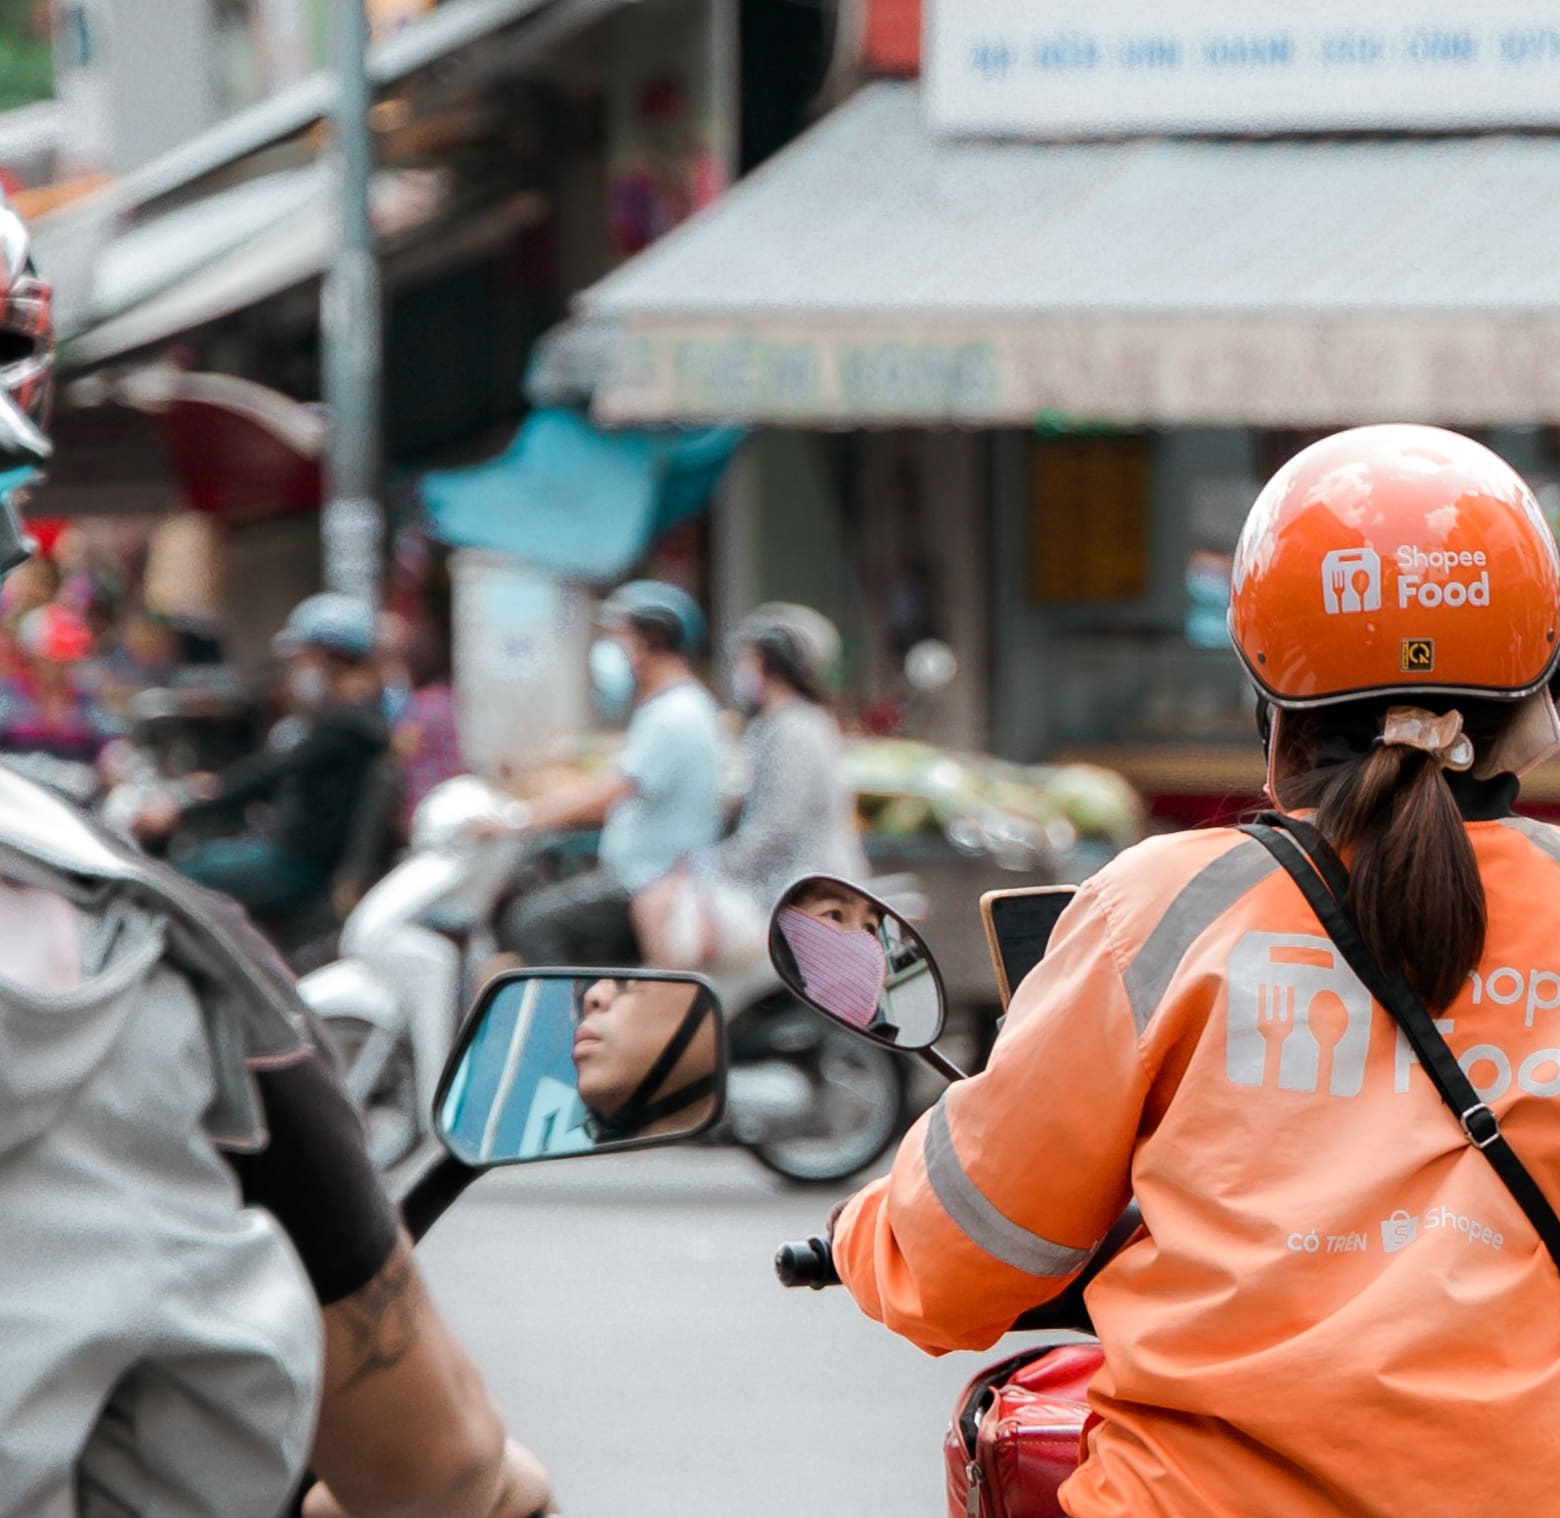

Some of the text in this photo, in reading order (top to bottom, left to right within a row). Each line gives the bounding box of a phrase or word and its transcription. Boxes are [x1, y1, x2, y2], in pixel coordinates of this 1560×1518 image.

[1397, 545, 1487, 575] Shopee
[1397, 571, 1490, 608] Food
[1287, 1228, 1320, 1253] CÓ
[1423, 1206, 1504, 1250] Shopee
